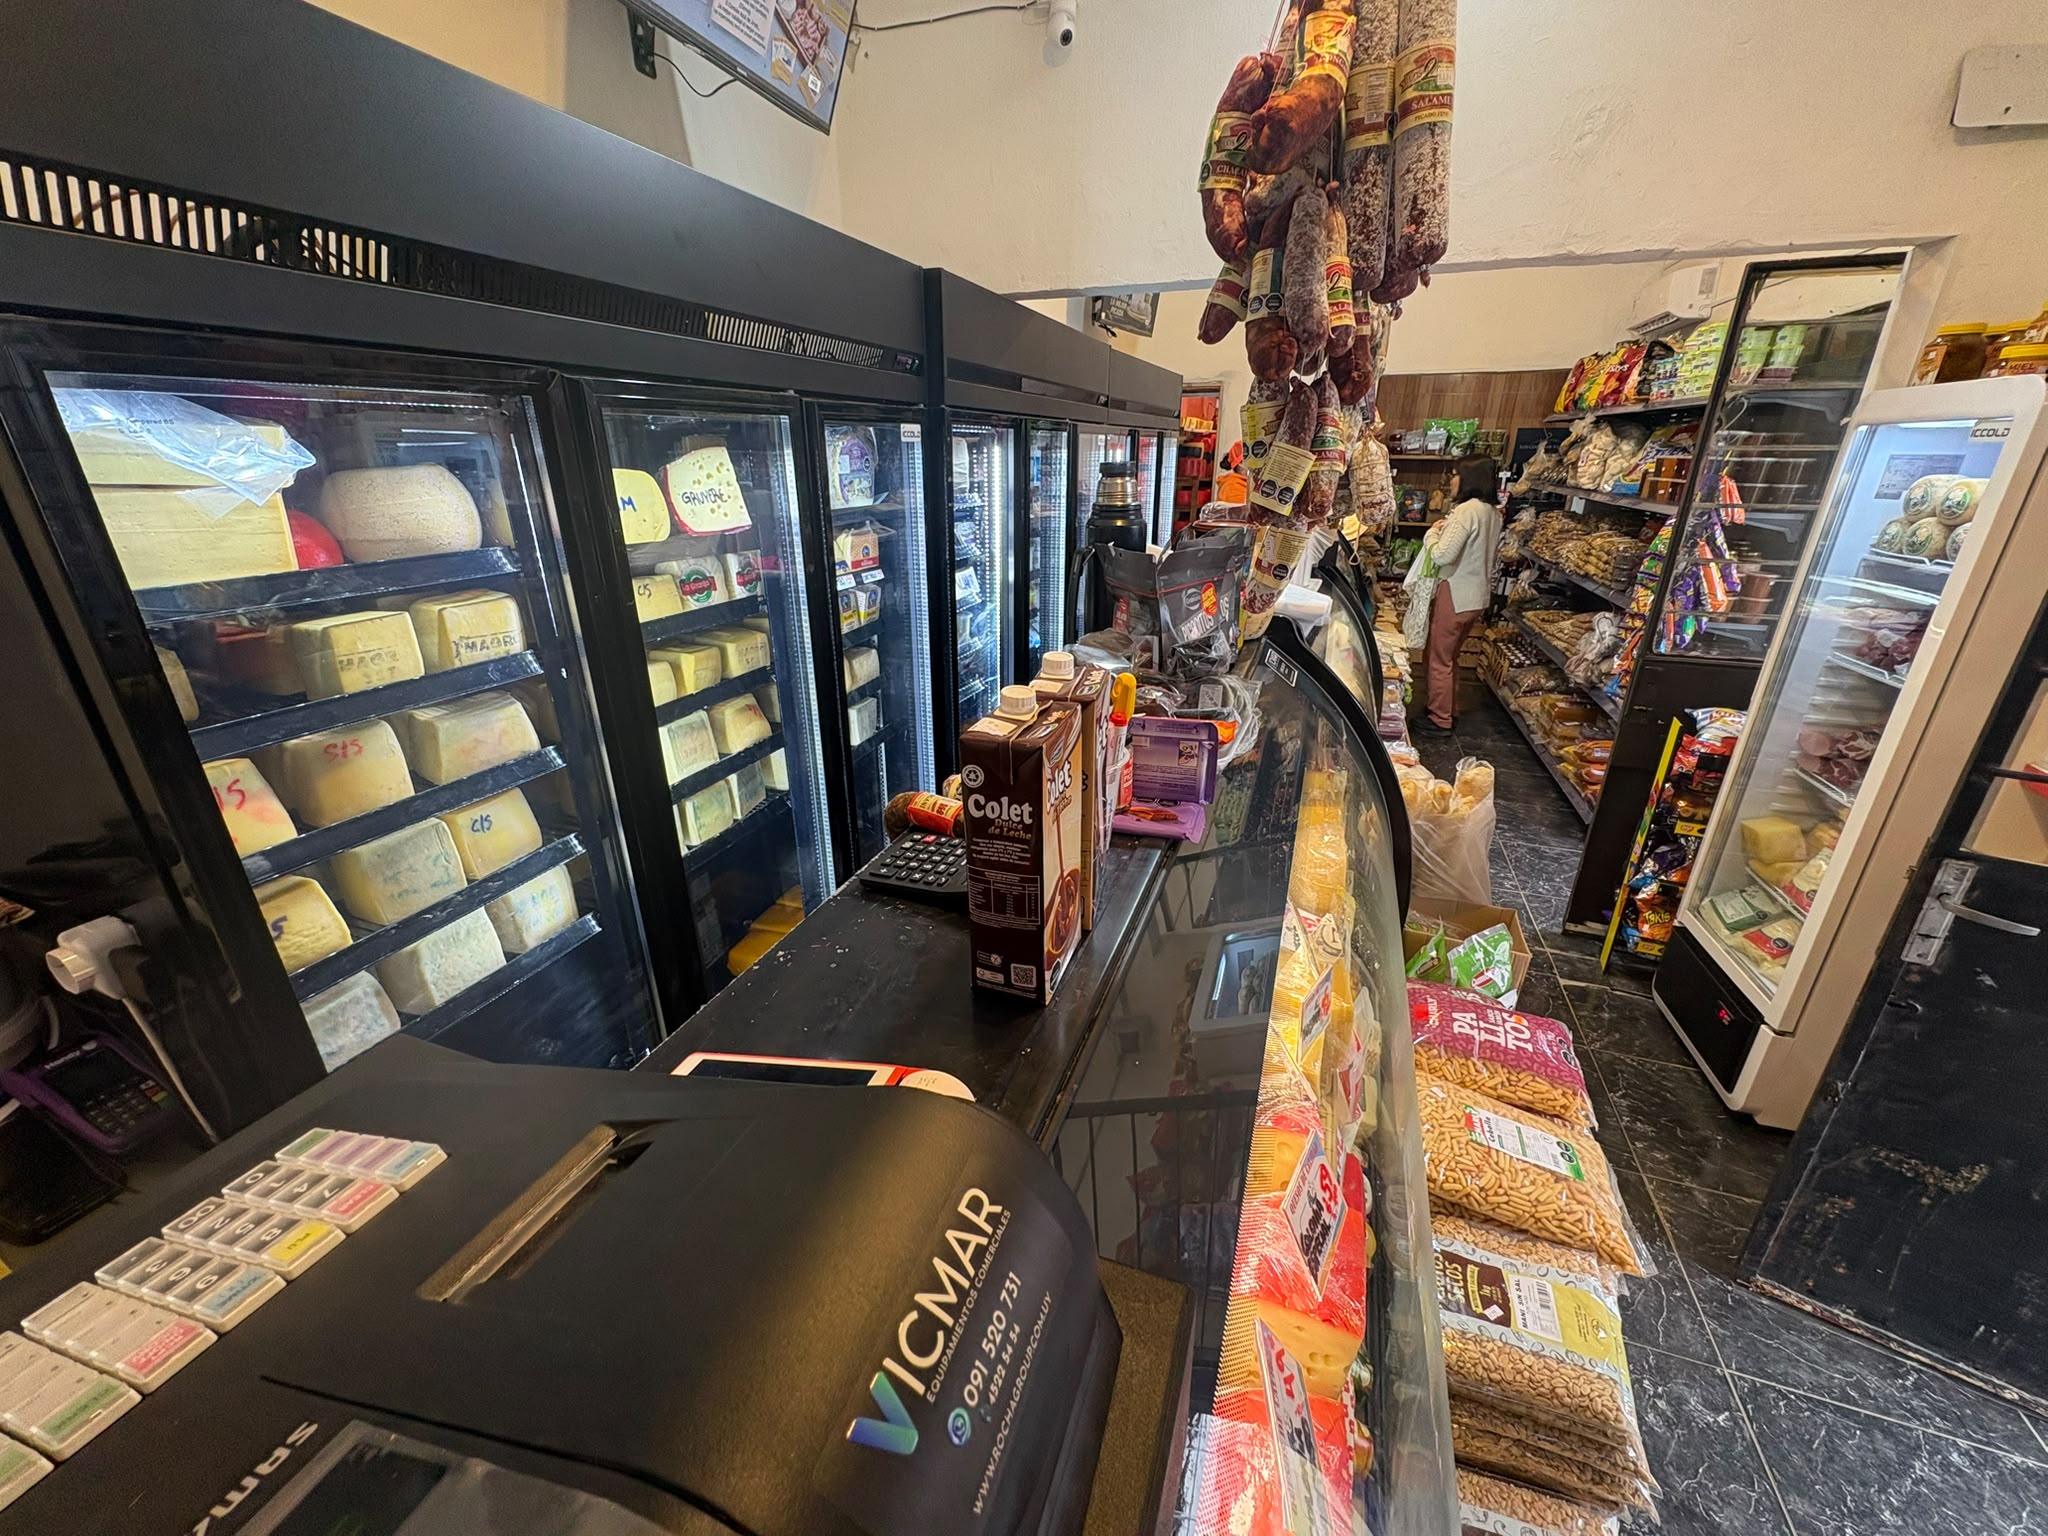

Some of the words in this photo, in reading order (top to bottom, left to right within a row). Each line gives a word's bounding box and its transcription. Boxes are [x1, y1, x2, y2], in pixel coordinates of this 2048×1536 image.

[1970, 428, 2011, 438] ICCOLD
[967, 793, 1033, 825] Colet
[988, 826, 1001, 836] de
[1002, 827, 1032, 842] Leche
[994, 818, 1024, 832] Dulce
[1642, 908, 1671, 927] Takis
[1452, 1012, 1480, 1037] PA
[1479, 1020, 1507, 1047] LI
[1445, 1260, 1466, 1304] SECOS
[926, 1290, 978, 1405] EQUIPAMIENTOS
[974, 1209, 1012, 1289] COMERCIALES
[1517, 1293, 1525, 1306] SIN
[846, 1187, 1003, 1456] VICMAR
[963, 1359, 989, 1408] 091
[982, 1309, 1007, 1360] 520
[1000, 1270, 1022, 1310] 731
[988, 1364, 1007, 1407] 4522
[1001, 1346, 1014, 1366] 54
[1009, 1323, 1022, 1345] 54
